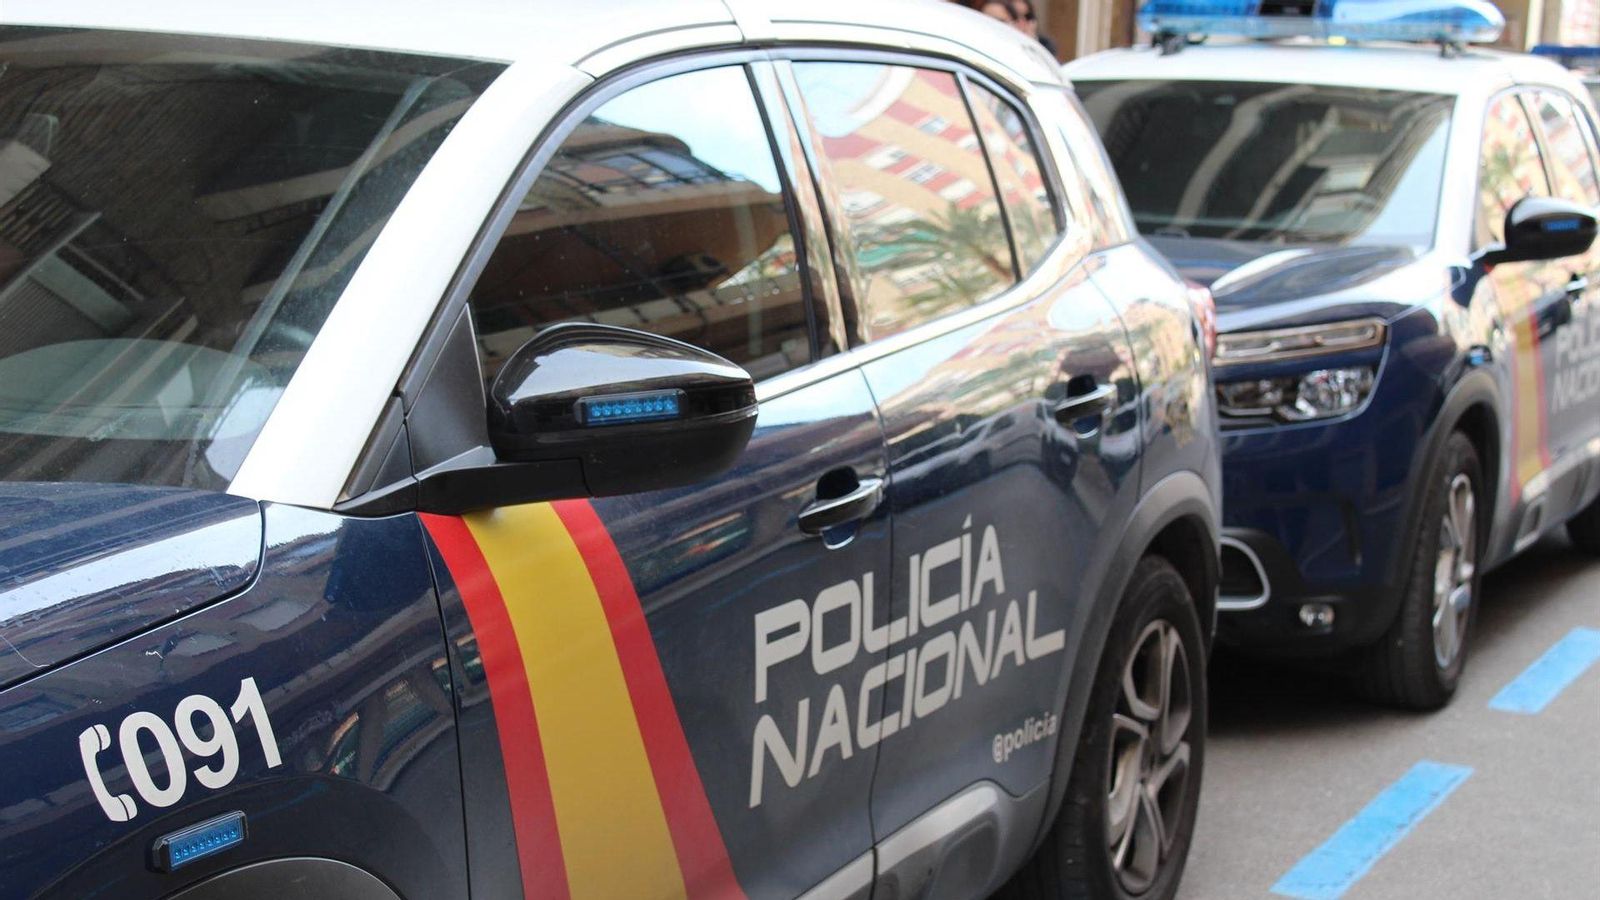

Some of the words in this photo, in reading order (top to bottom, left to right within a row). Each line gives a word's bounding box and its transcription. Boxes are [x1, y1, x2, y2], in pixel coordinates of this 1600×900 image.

[754, 514, 1006, 704] POLICÍA
[118, 676, 283, 808] 091
[749, 590, 1066, 809] NACIONAL
[991, 711, 1058, 764] @policia
